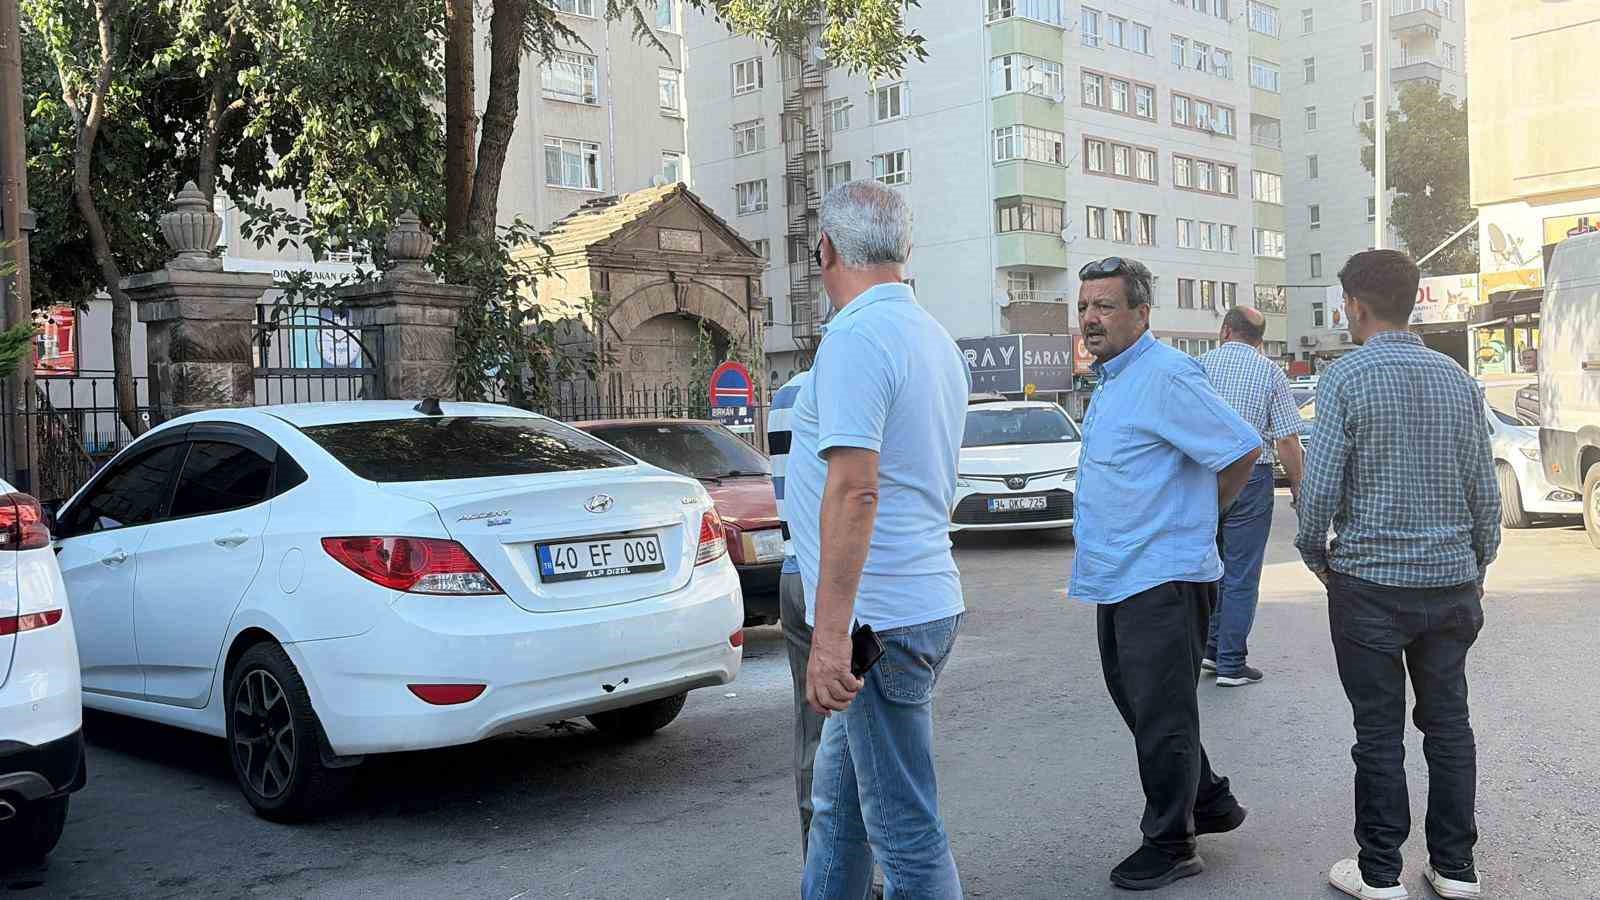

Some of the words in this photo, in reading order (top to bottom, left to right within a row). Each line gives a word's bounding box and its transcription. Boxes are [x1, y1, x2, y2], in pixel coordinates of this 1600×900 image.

[1023, 351, 1070, 365] SARAY
[1028, 498, 1045, 508] 725
[554, 547, 578, 569] 40
[588, 543, 612, 567] EF
[624, 540, 657, 563] 009
[585, 569, 605, 577] ALP
